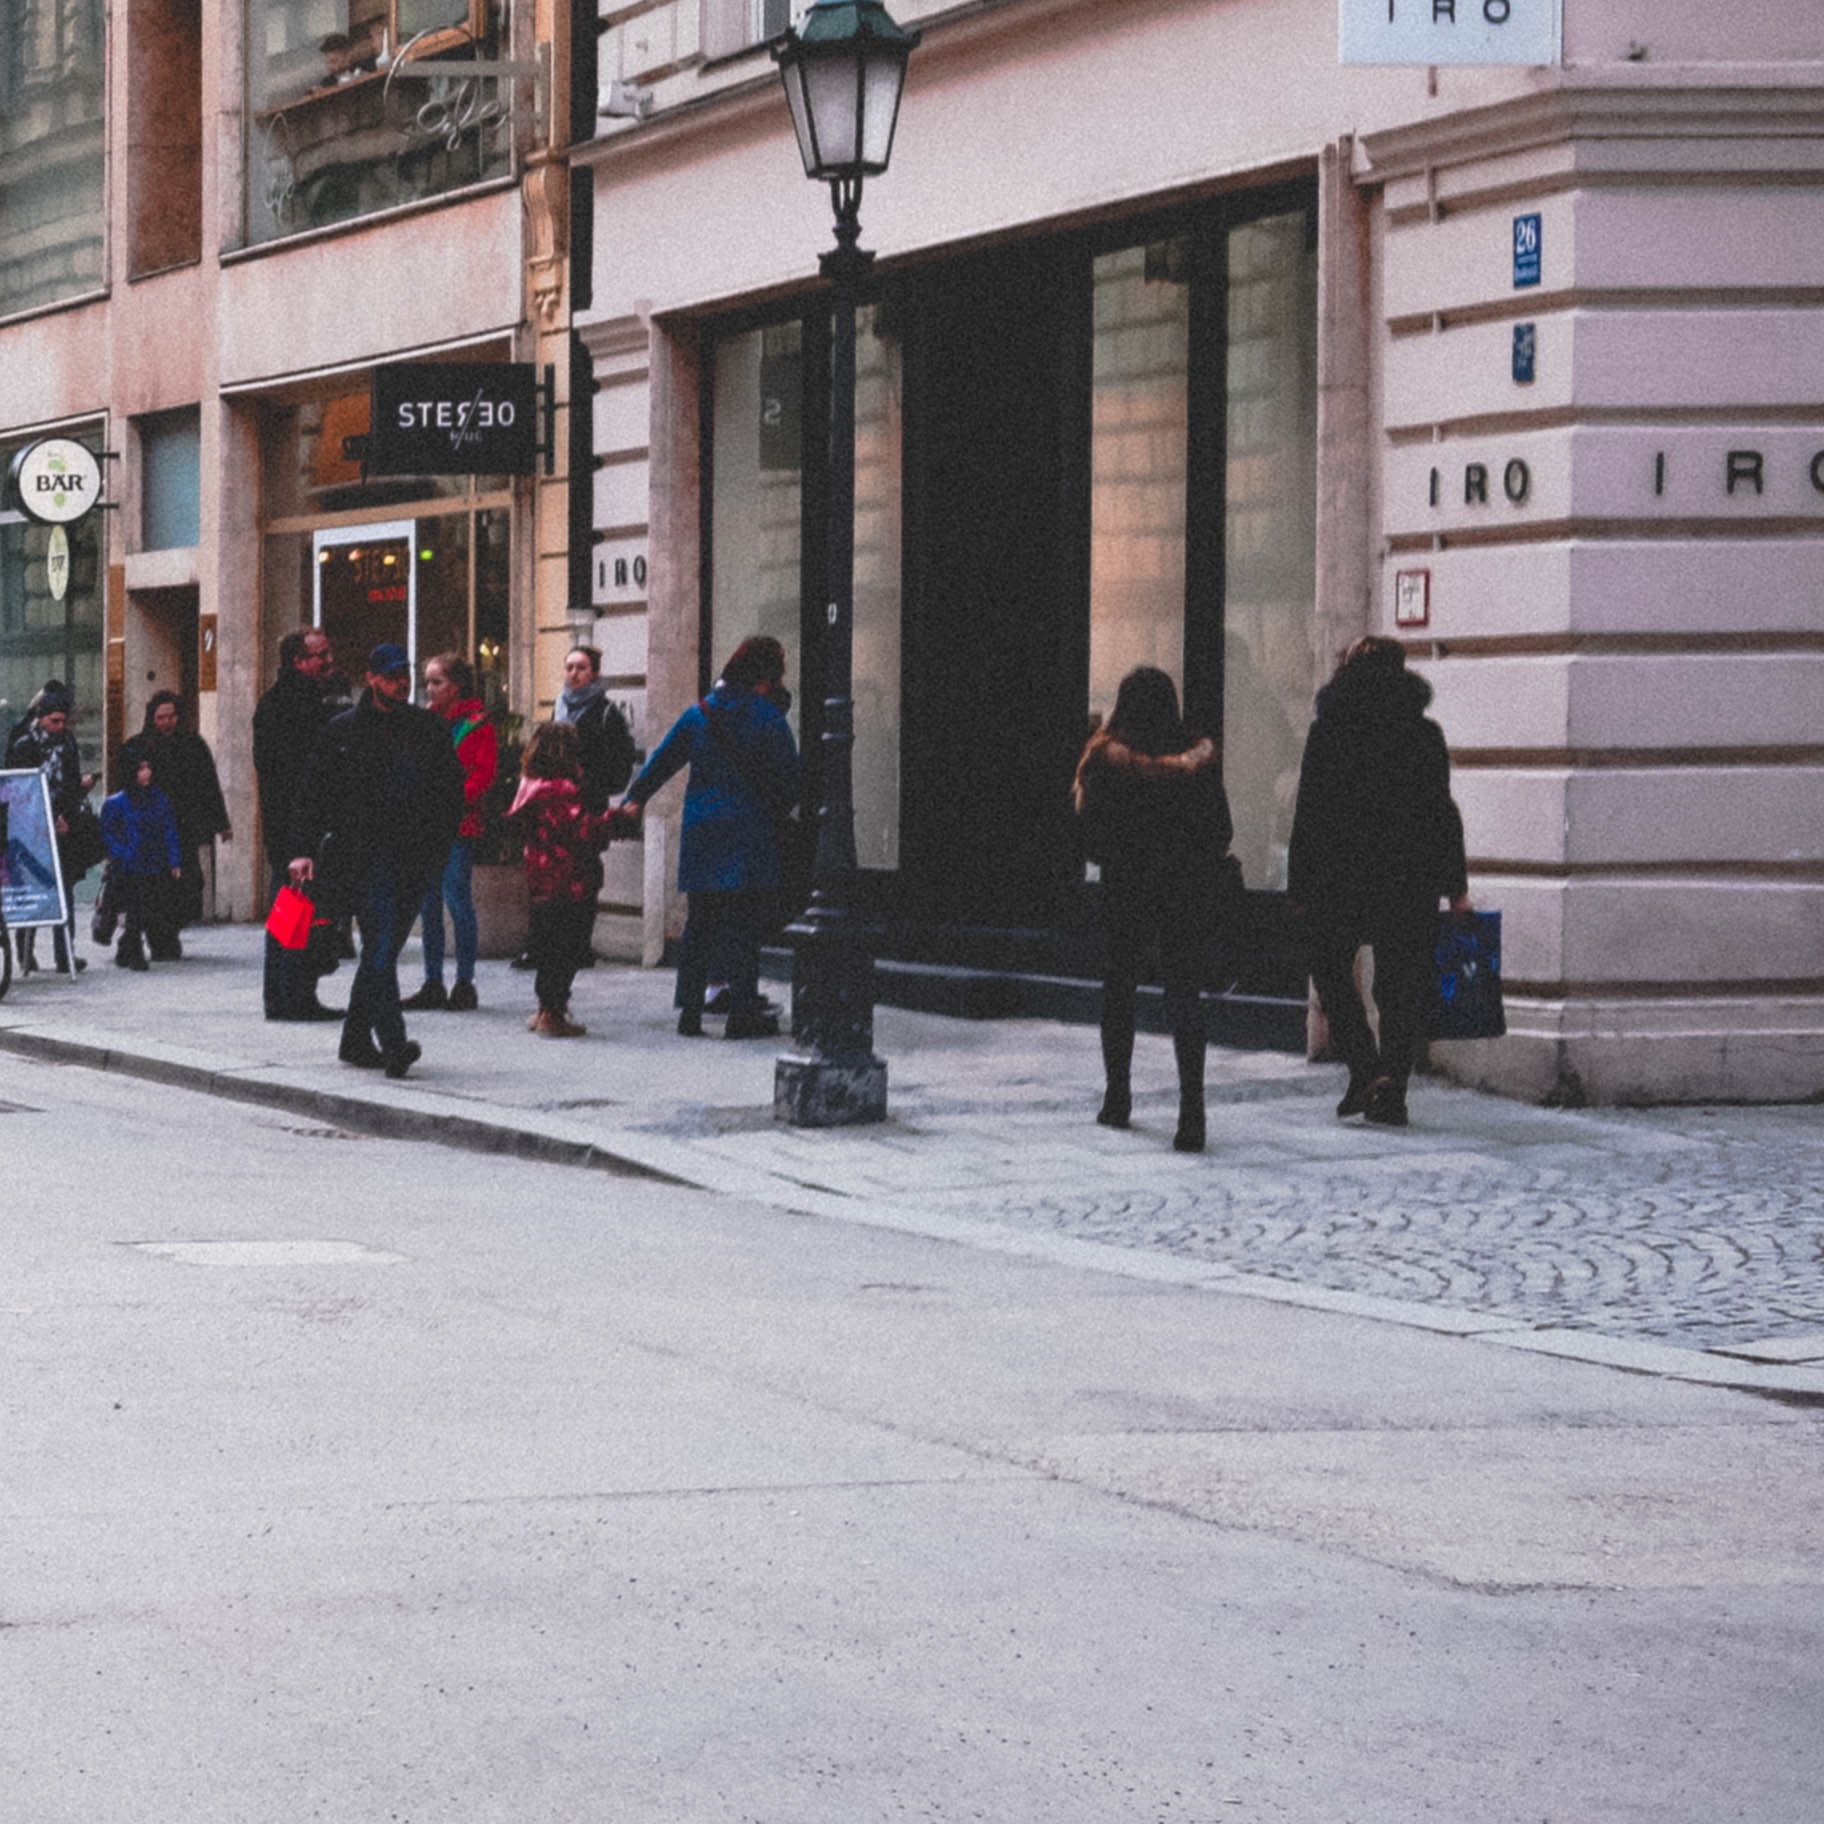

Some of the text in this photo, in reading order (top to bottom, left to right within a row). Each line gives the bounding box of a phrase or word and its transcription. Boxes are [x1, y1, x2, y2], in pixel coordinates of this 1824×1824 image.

[1516, 219, 1536, 254] 26
[1429, 457, 1530, 507] IRO
[599, 555, 647, 590] IRO
